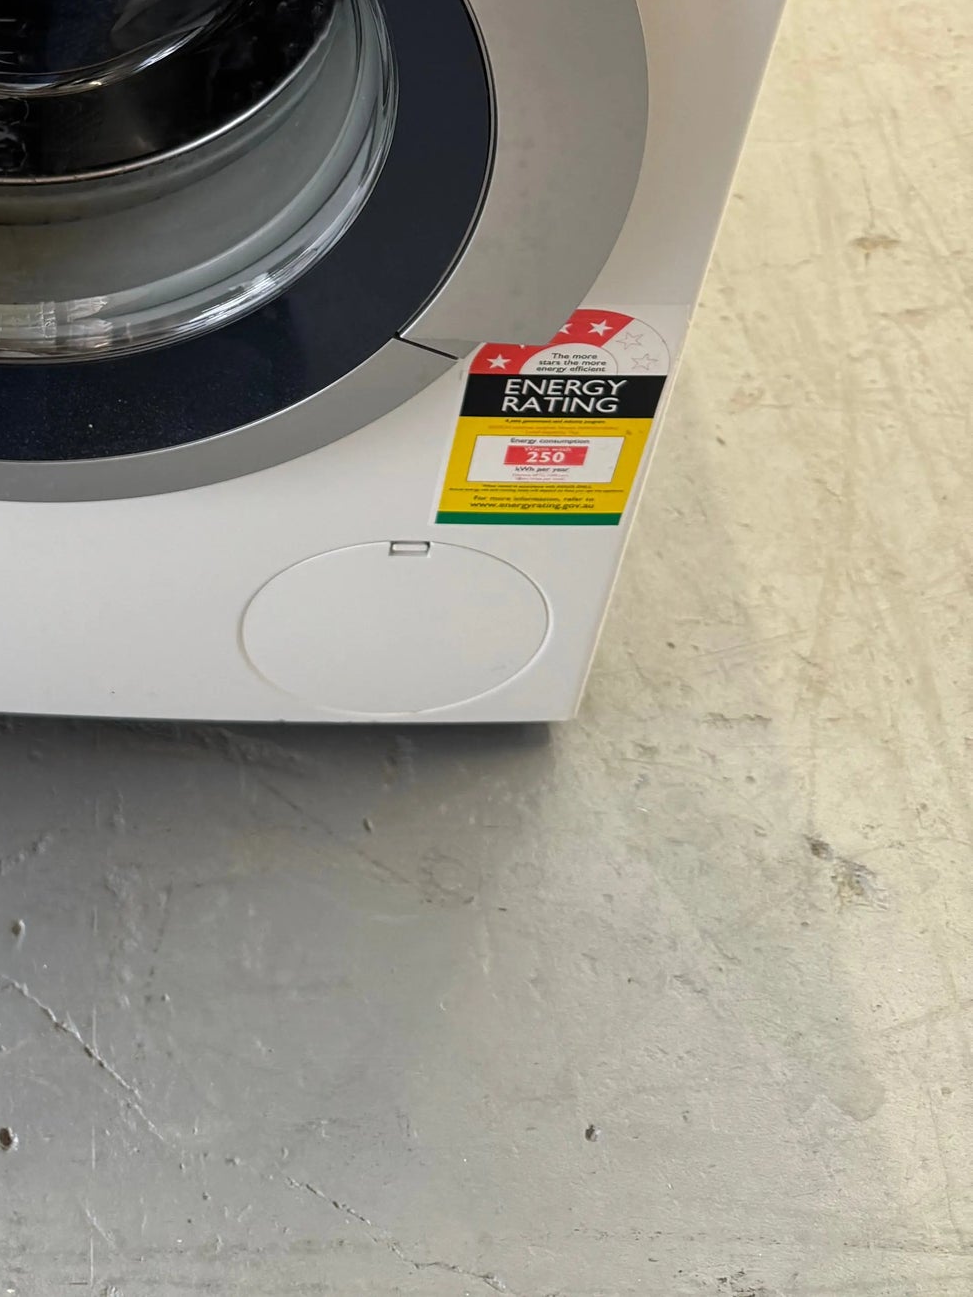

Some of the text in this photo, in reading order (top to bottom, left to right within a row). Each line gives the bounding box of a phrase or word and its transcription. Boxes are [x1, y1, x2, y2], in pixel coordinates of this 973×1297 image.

[505, 379, 627, 396] ENERGY
[501, 396, 619, 413] RATING
[526, 452, 565, 462] 250
[470, 502, 594, 510] www.energyrating.gov.au
